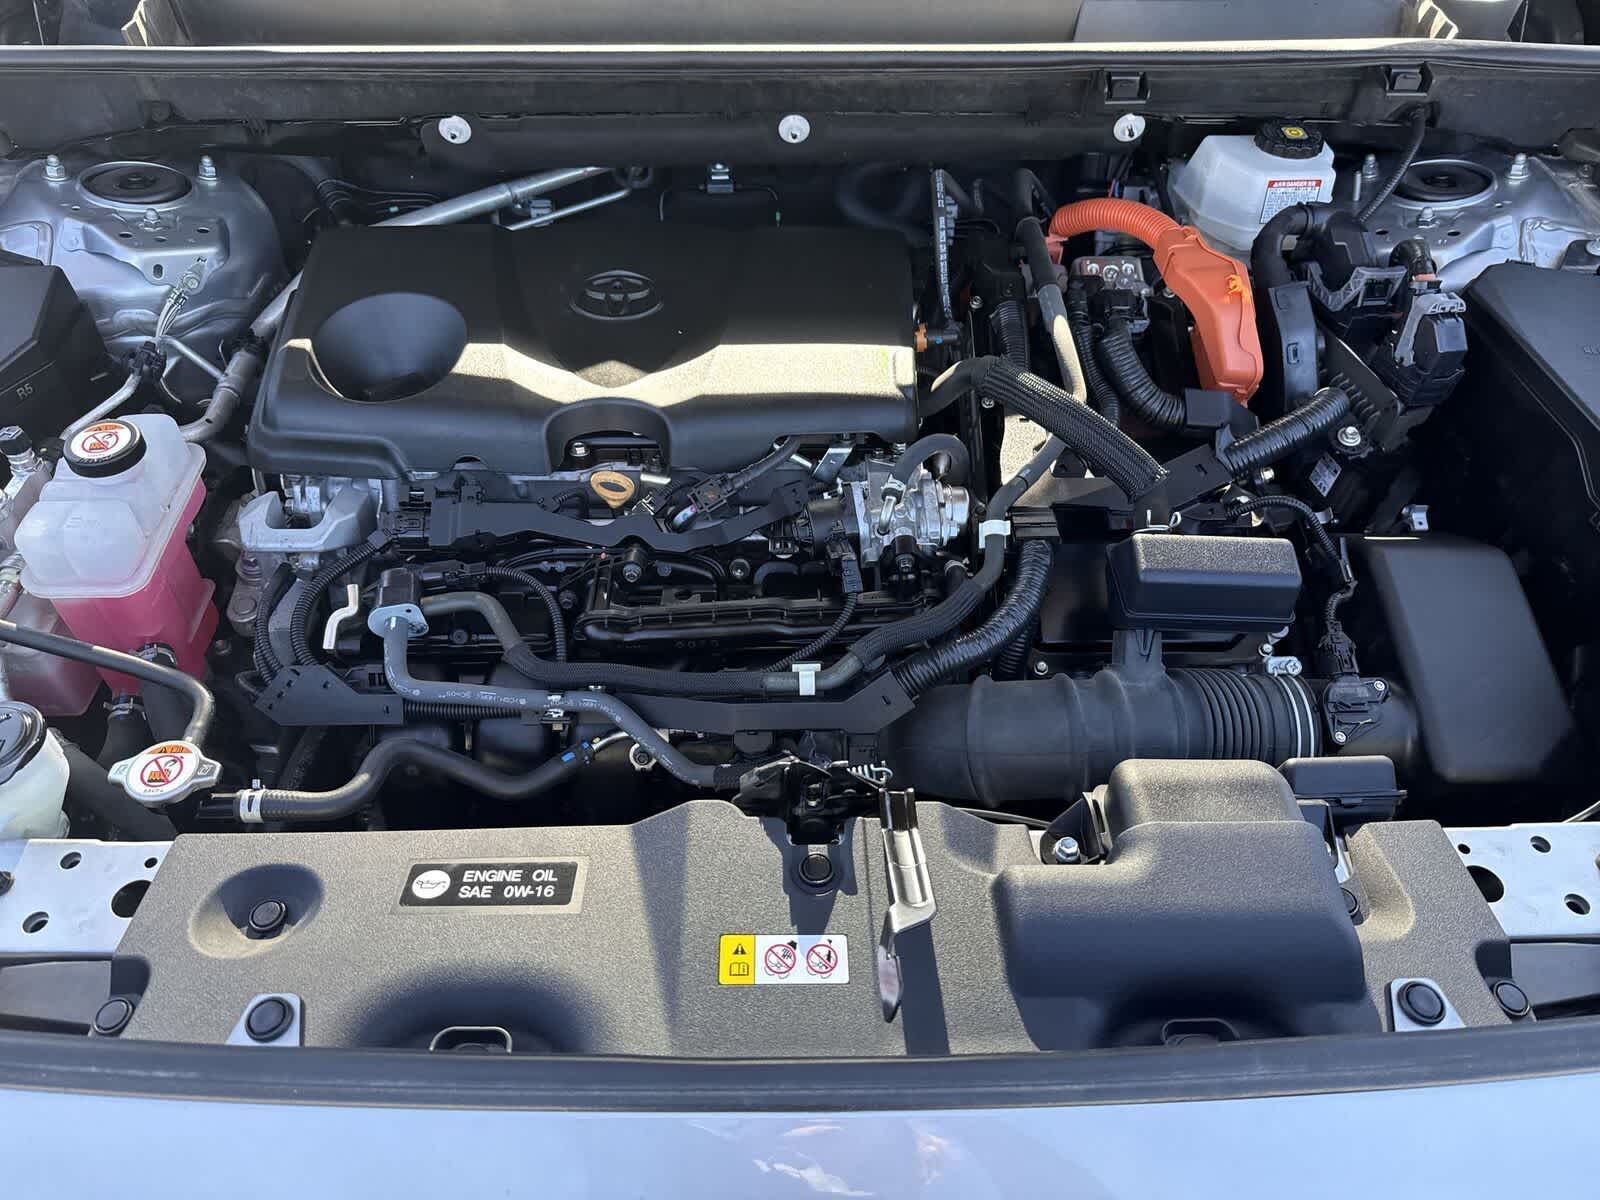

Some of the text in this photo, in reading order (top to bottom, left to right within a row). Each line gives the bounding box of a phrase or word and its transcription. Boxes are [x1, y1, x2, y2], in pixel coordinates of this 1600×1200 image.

[462, 869, 558, 883] ENGINE OIL
[458, 885, 555, 899] SAE 0W-16
